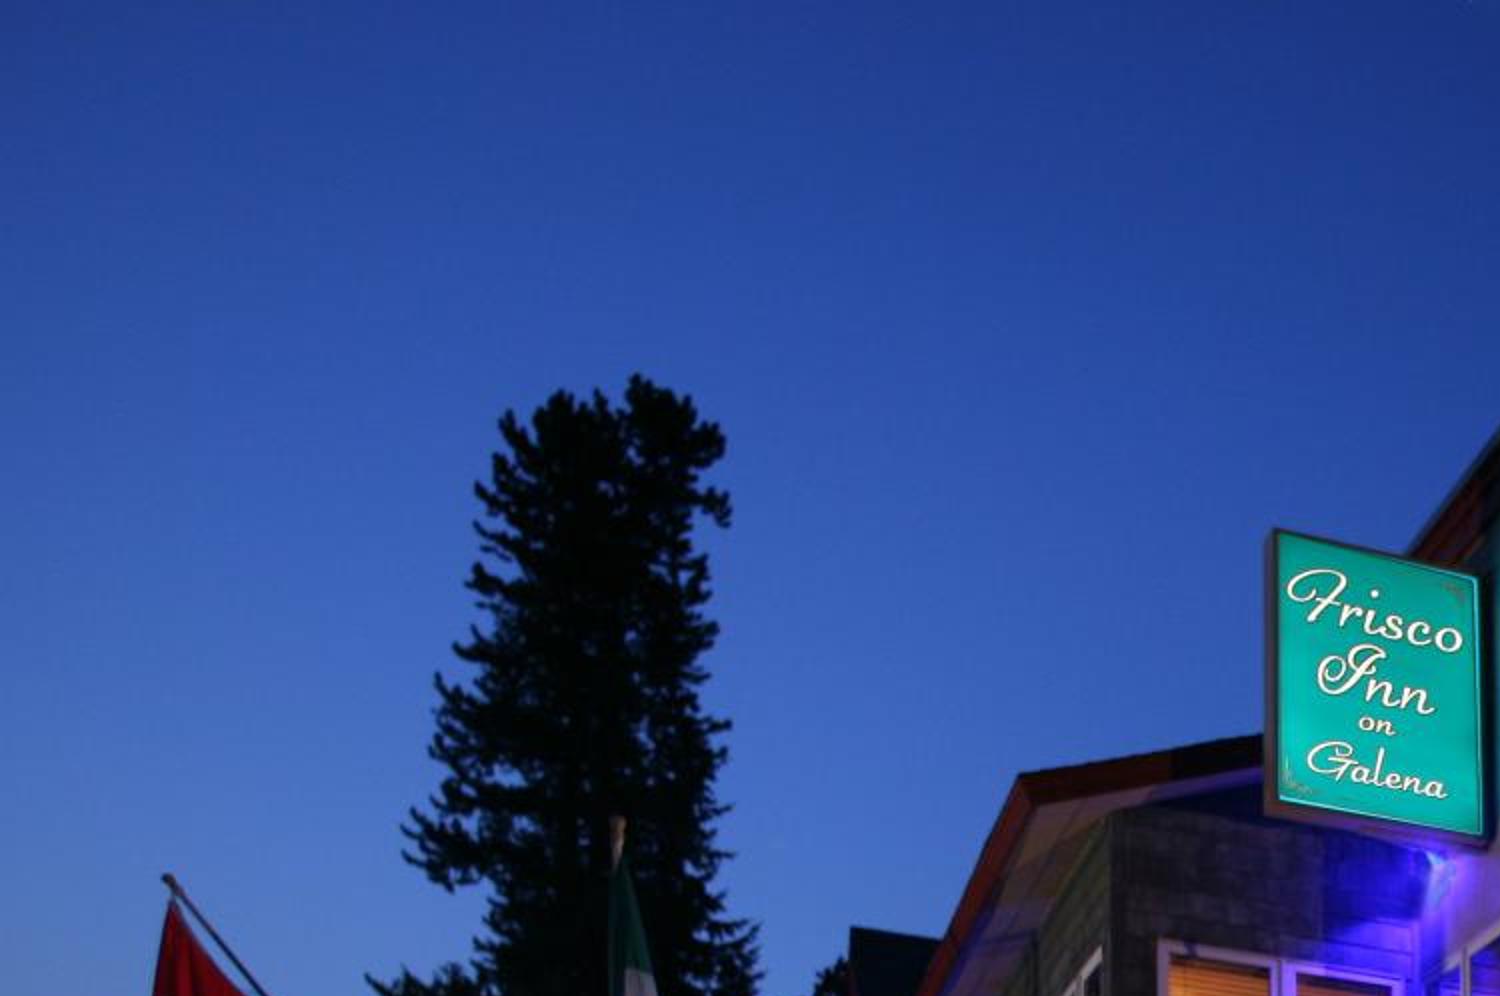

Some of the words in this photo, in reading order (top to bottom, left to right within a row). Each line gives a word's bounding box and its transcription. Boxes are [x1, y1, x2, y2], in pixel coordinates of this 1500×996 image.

[1286, 568, 1464, 653] Frisco
[1317, 643, 1436, 715] Inn
[1358, 715, 1396, 736] on
[1306, 740, 1448, 799] Galena
